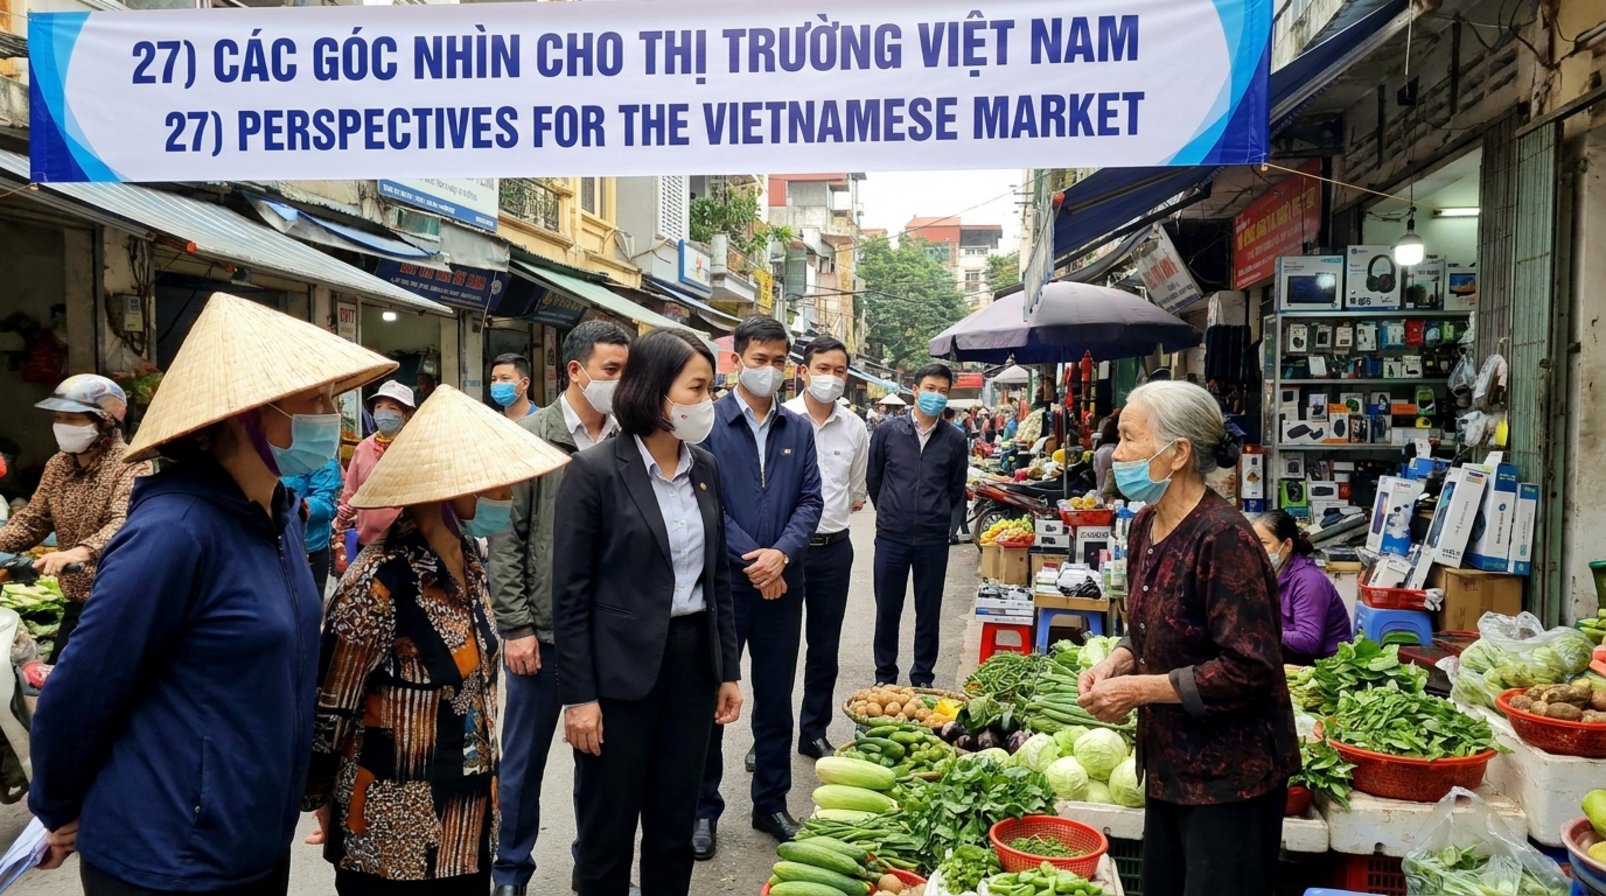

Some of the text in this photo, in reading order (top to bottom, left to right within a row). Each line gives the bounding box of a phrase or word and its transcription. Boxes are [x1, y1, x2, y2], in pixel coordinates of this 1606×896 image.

[133, 10, 1139, 89] 27) CÁC GÓC NHÌN CHO THỊ TRƯỜNG VIỆT NAM
[165, 91, 1145, 156] 27) PERSPECTIVES FOR THE VIETNAMESE MARKET
